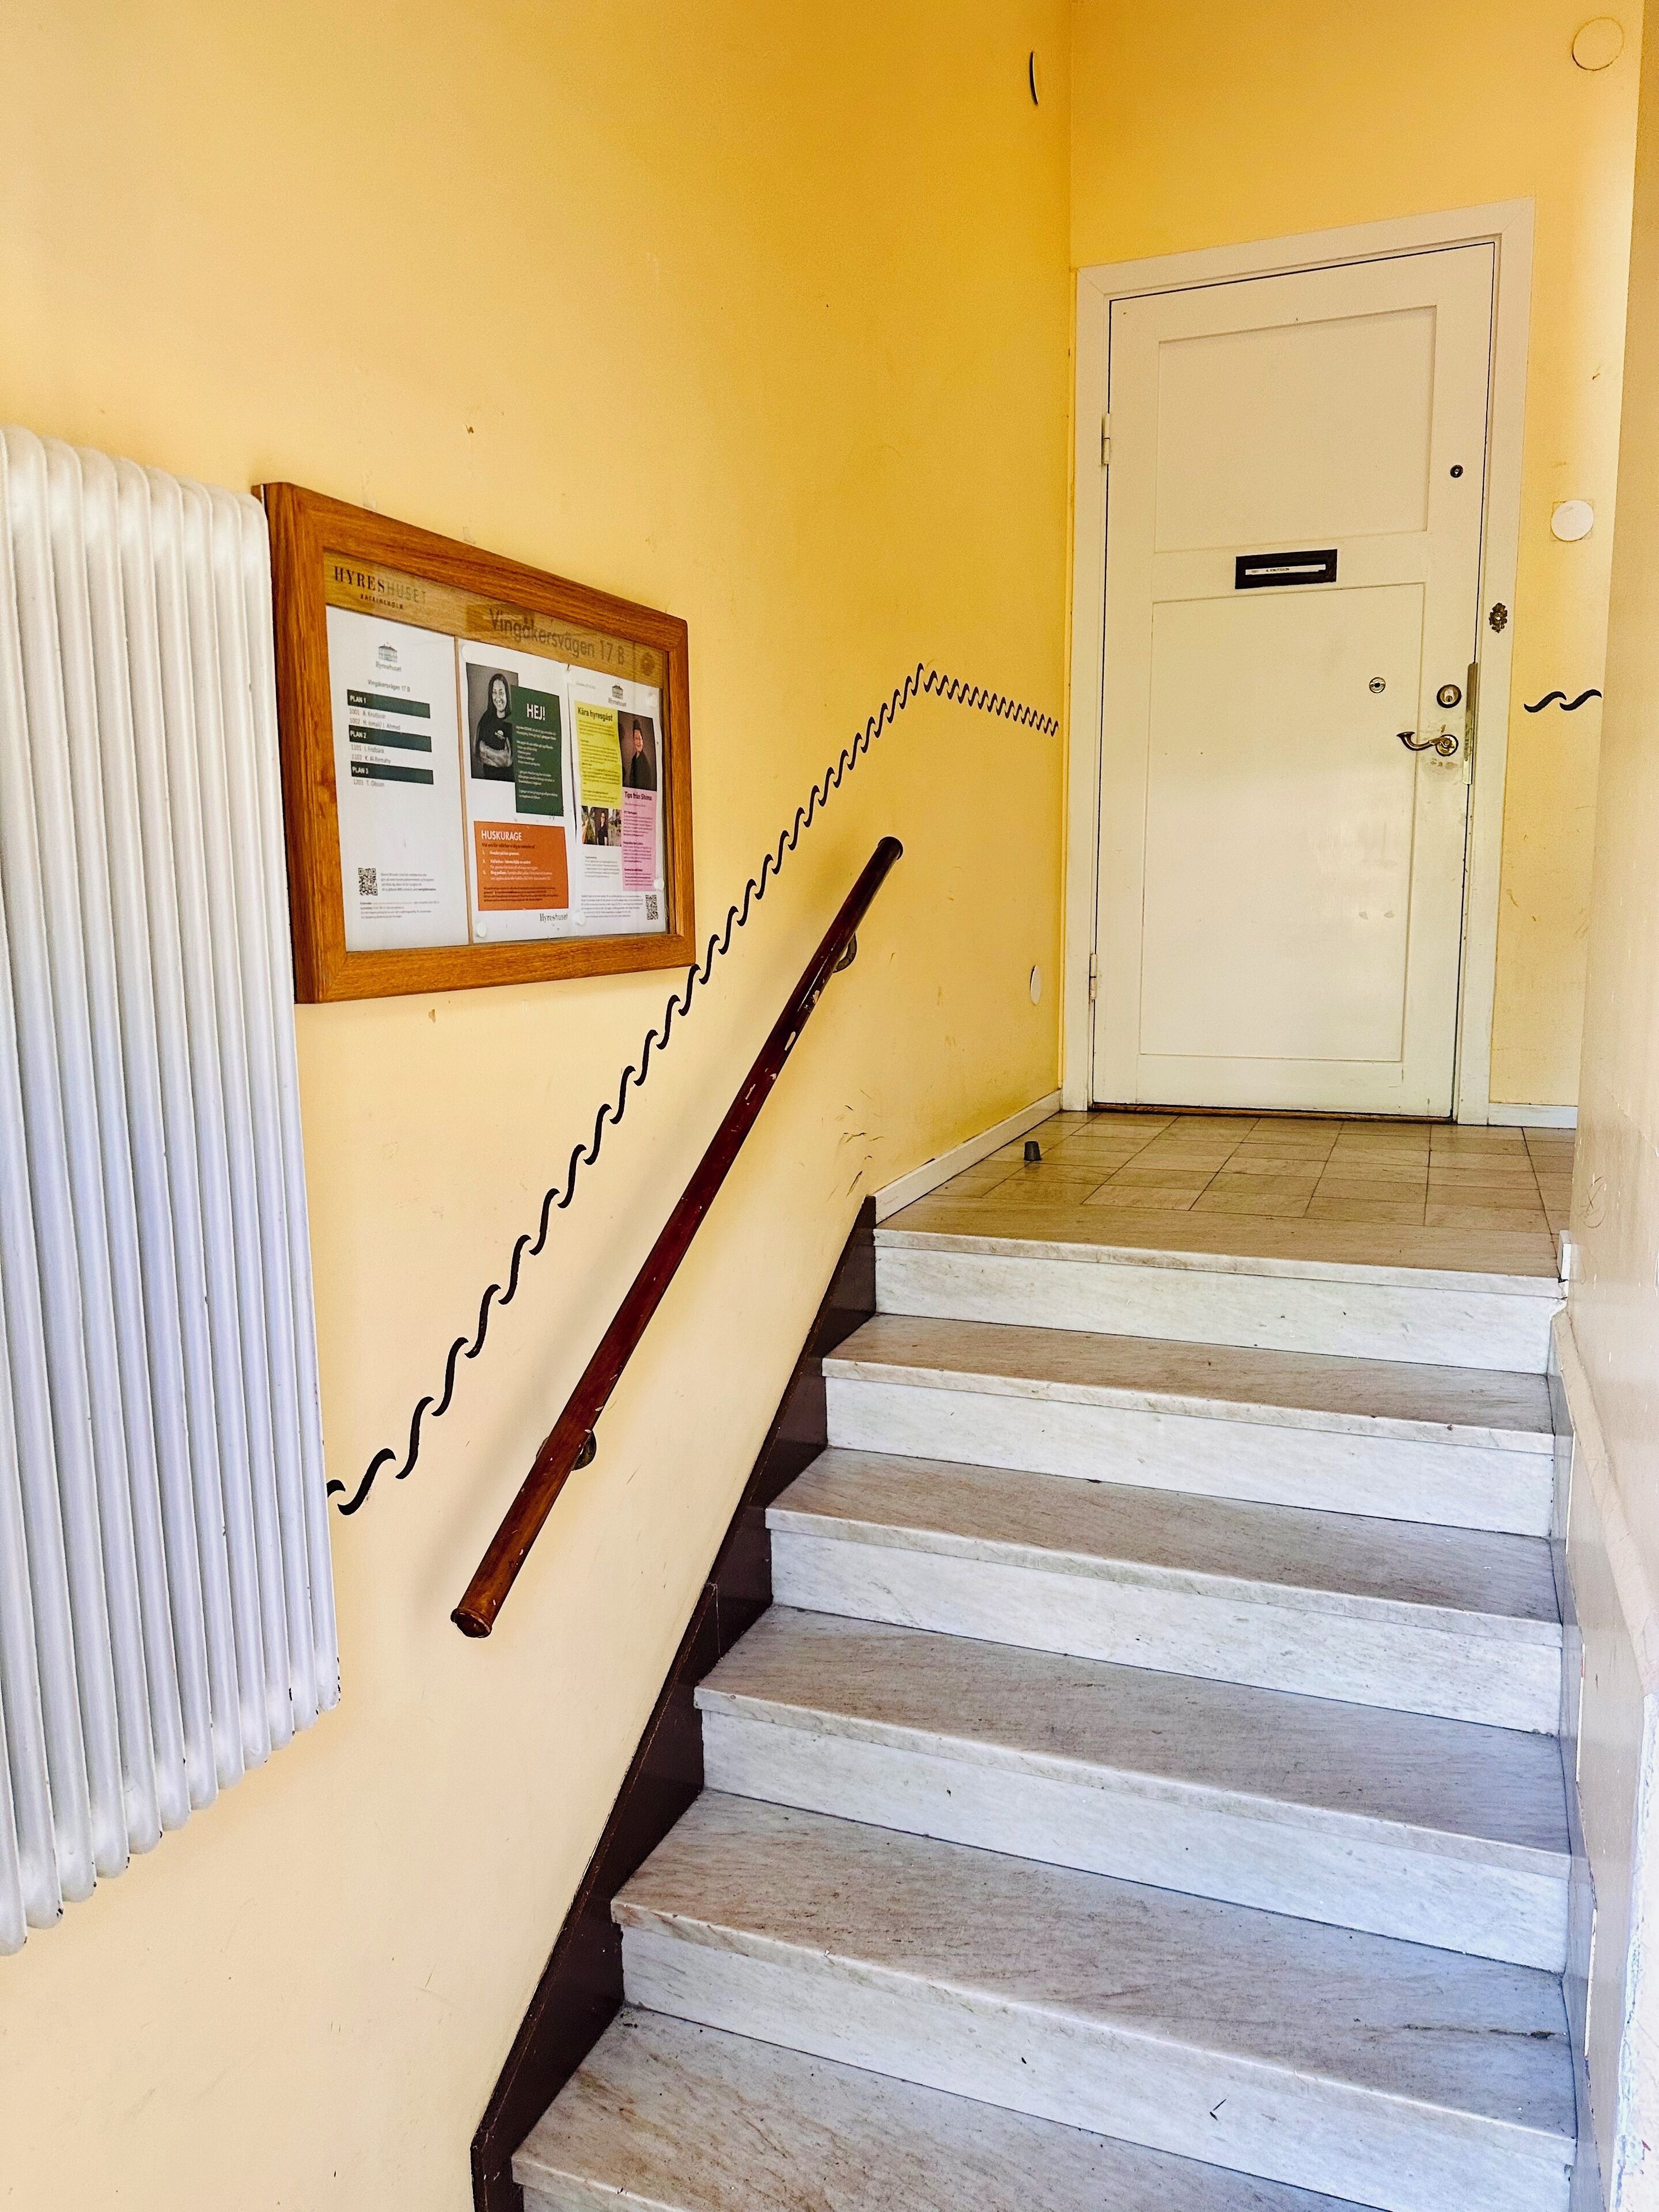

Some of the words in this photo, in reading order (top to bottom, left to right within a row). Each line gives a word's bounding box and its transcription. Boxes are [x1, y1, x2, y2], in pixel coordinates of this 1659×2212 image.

[334, 566, 426, 604] HYRESHUSET
[490, 608, 594, 658] Vingåkersvägen
[600, 639, 613, 663] 17
[618, 645, 624, 665] B
[350, 695, 363, 703] PLAN
[527, 703, 546, 721] HEJ!
[577, 706, 589, 717] Kära
[589, 711, 613, 722] hyresgäst
[350, 730, 363, 738] PLAN
[351, 766, 366, 774] PLAN
[624, 791, 632, 800] Tips
[632, 791, 641, 800] från
[480, 830, 522, 841] HUSKURAGE
[539, 912, 568, 923] Hyreshuset
